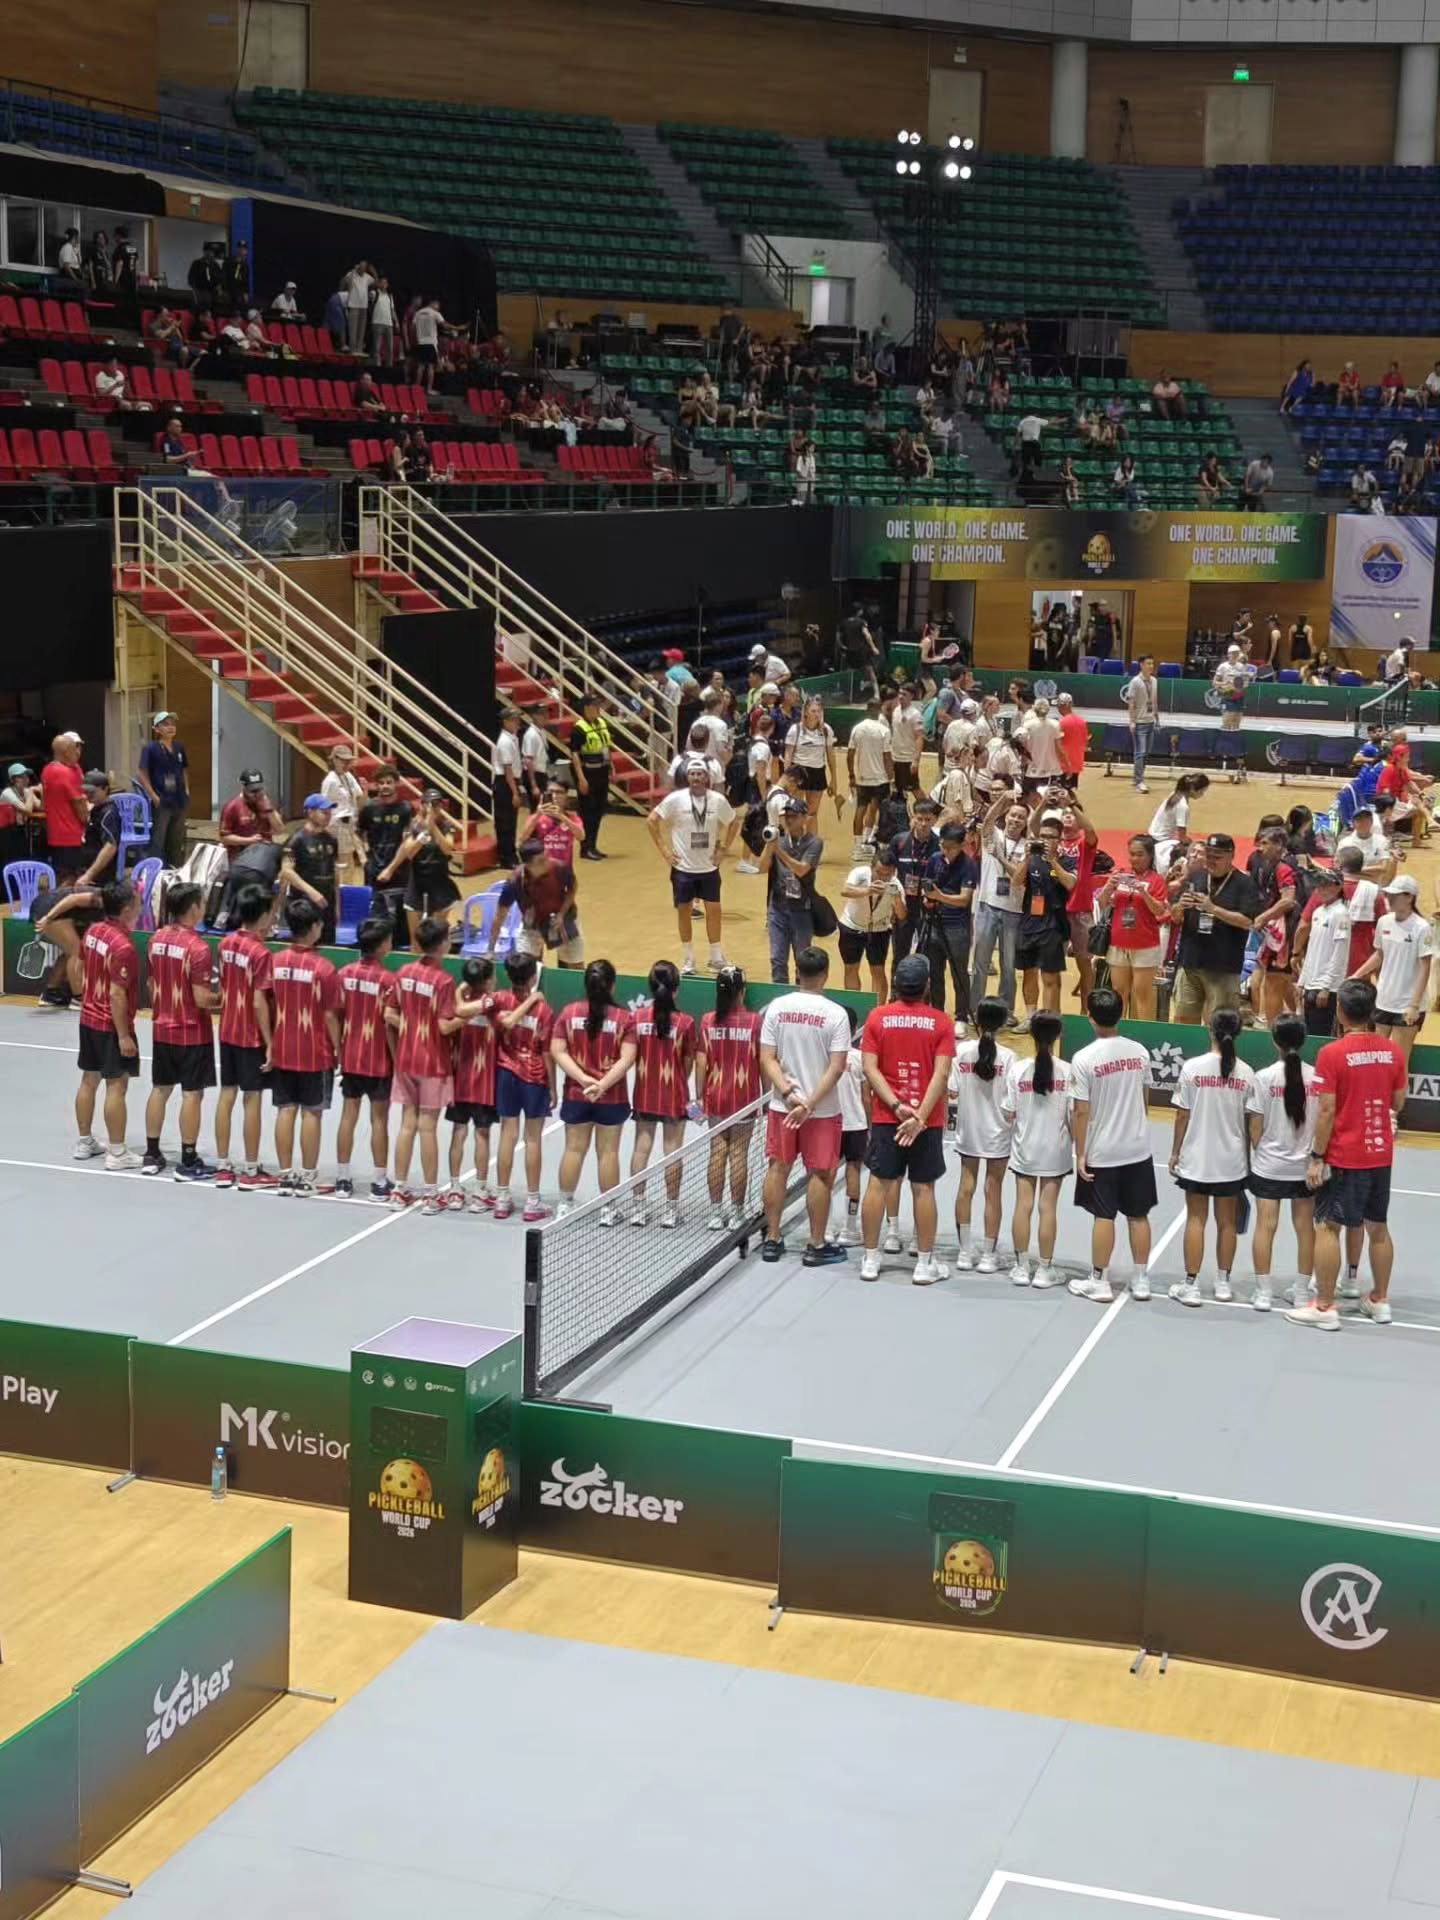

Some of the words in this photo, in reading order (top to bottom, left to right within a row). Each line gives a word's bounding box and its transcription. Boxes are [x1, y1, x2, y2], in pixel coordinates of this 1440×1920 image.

[886, 520, 910, 539] ONE
[964, 521, 987, 539] ONE
[991, 522, 1029, 540] GAME.
[1170, 525, 1191, 542] ONE
[1195, 525, 1237, 542] WORLD.
[1240, 525, 1262, 542] ONE
[1265, 525, 1301, 543] GAME.
[912, 544, 935, 562] ONE
[939, 544, 1006, 563] CHAMPION.
[1192, 547, 1214, 564] ONE
[1217, 547, 1279, 565] CHAMPION.
[778, 1011, 827, 1029] SINGAPORE
[882, 1015, 936, 1031] SINGAPORE
[1345, 1050, 1393, 1067] SINGAPORE
[1094, 1058, 1143, 1078] SINGAPORE
[1194, 1075, 1246, 1092] SINGAPORE
[2, 1375, 58, 1413] Play
[368, 1491, 446, 1520] PICKLEBALL
[382, 1510, 411, 1526] WORLD
[413, 1515, 431, 1530] CUP
[932, 1569, 1007, 1592] PICKLEBALL
[944, 1585, 973, 1599] WORLD
[975, 1588, 993, 1601] CUP
